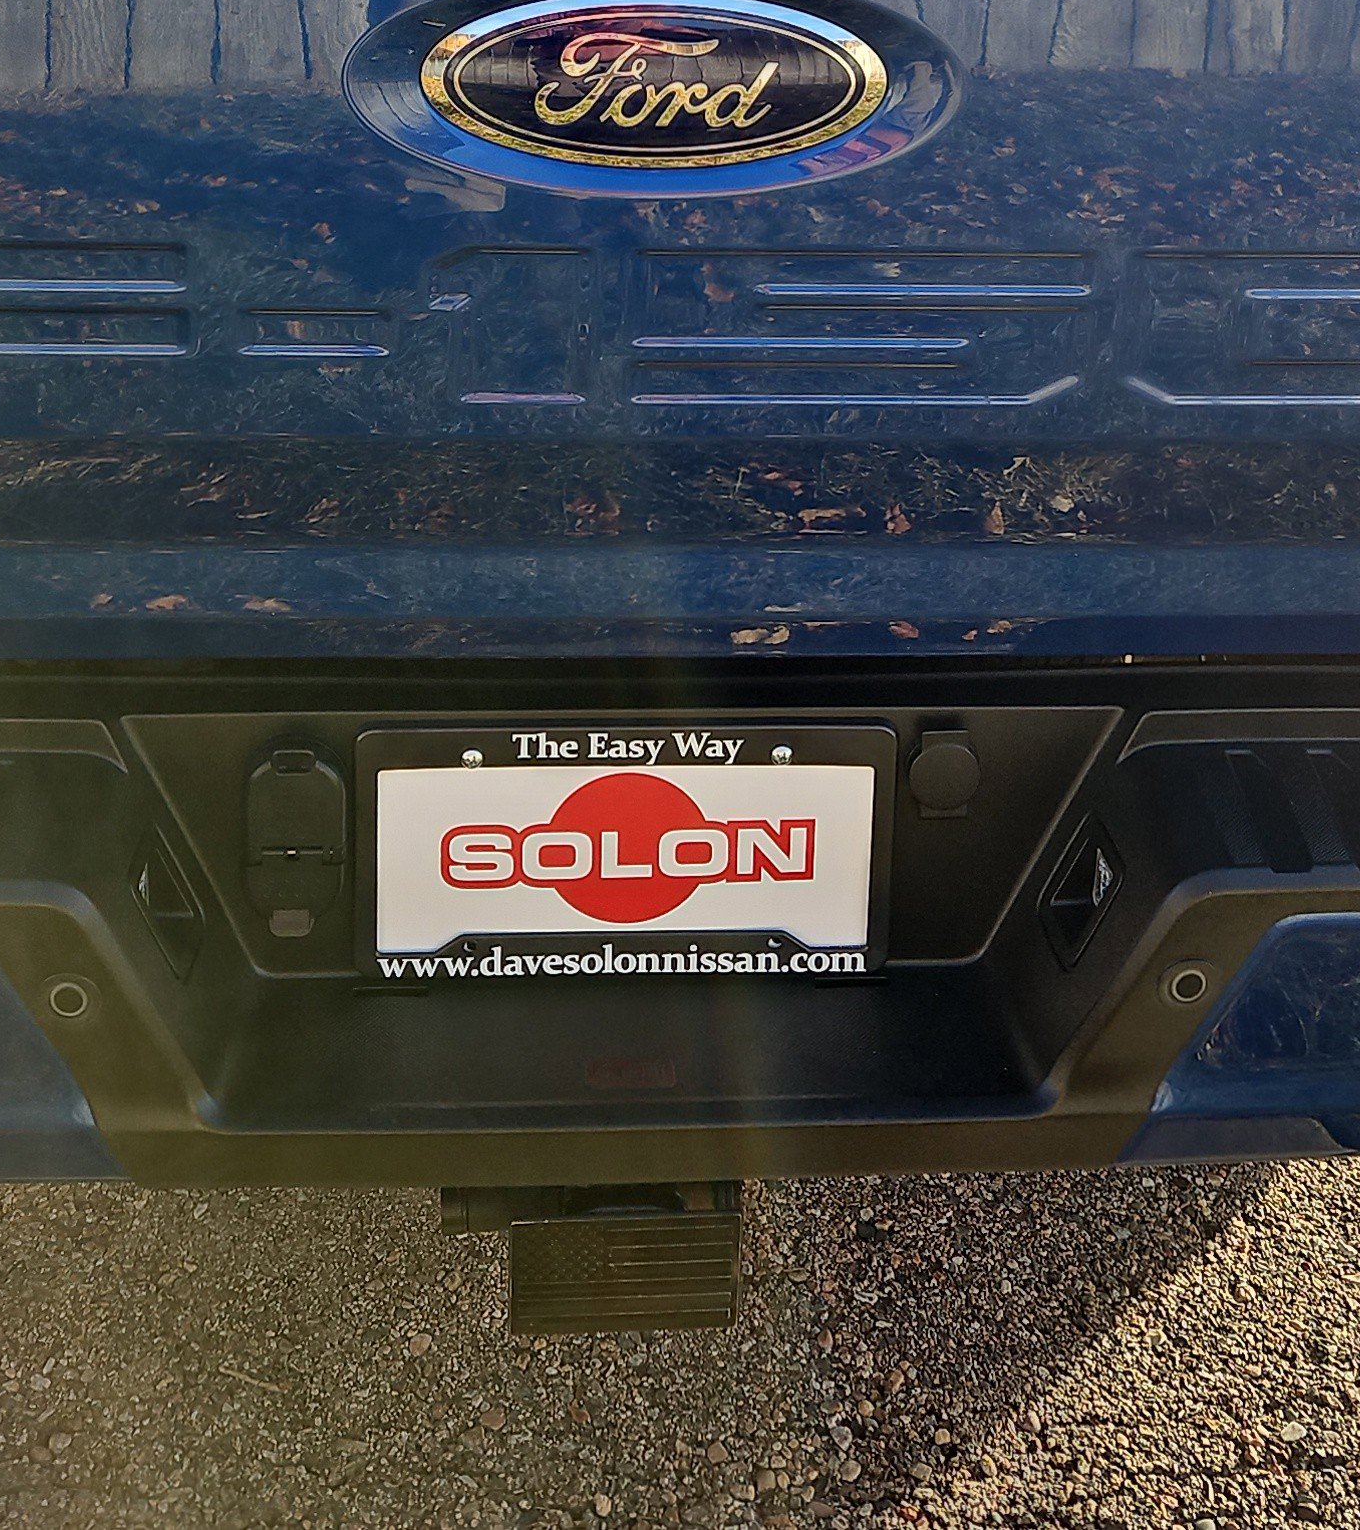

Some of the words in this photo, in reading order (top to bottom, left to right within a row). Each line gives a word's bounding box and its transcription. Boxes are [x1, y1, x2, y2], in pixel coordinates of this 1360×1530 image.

[534, 32, 778, 129] Ford
[512, 733, 579, 760] The
[587, 733, 666, 765] Easy
[671, 733, 744, 765] Way
[444, 823, 813, 885] SOLON
[378, 944, 867, 977] www.davesolonnissan.com
